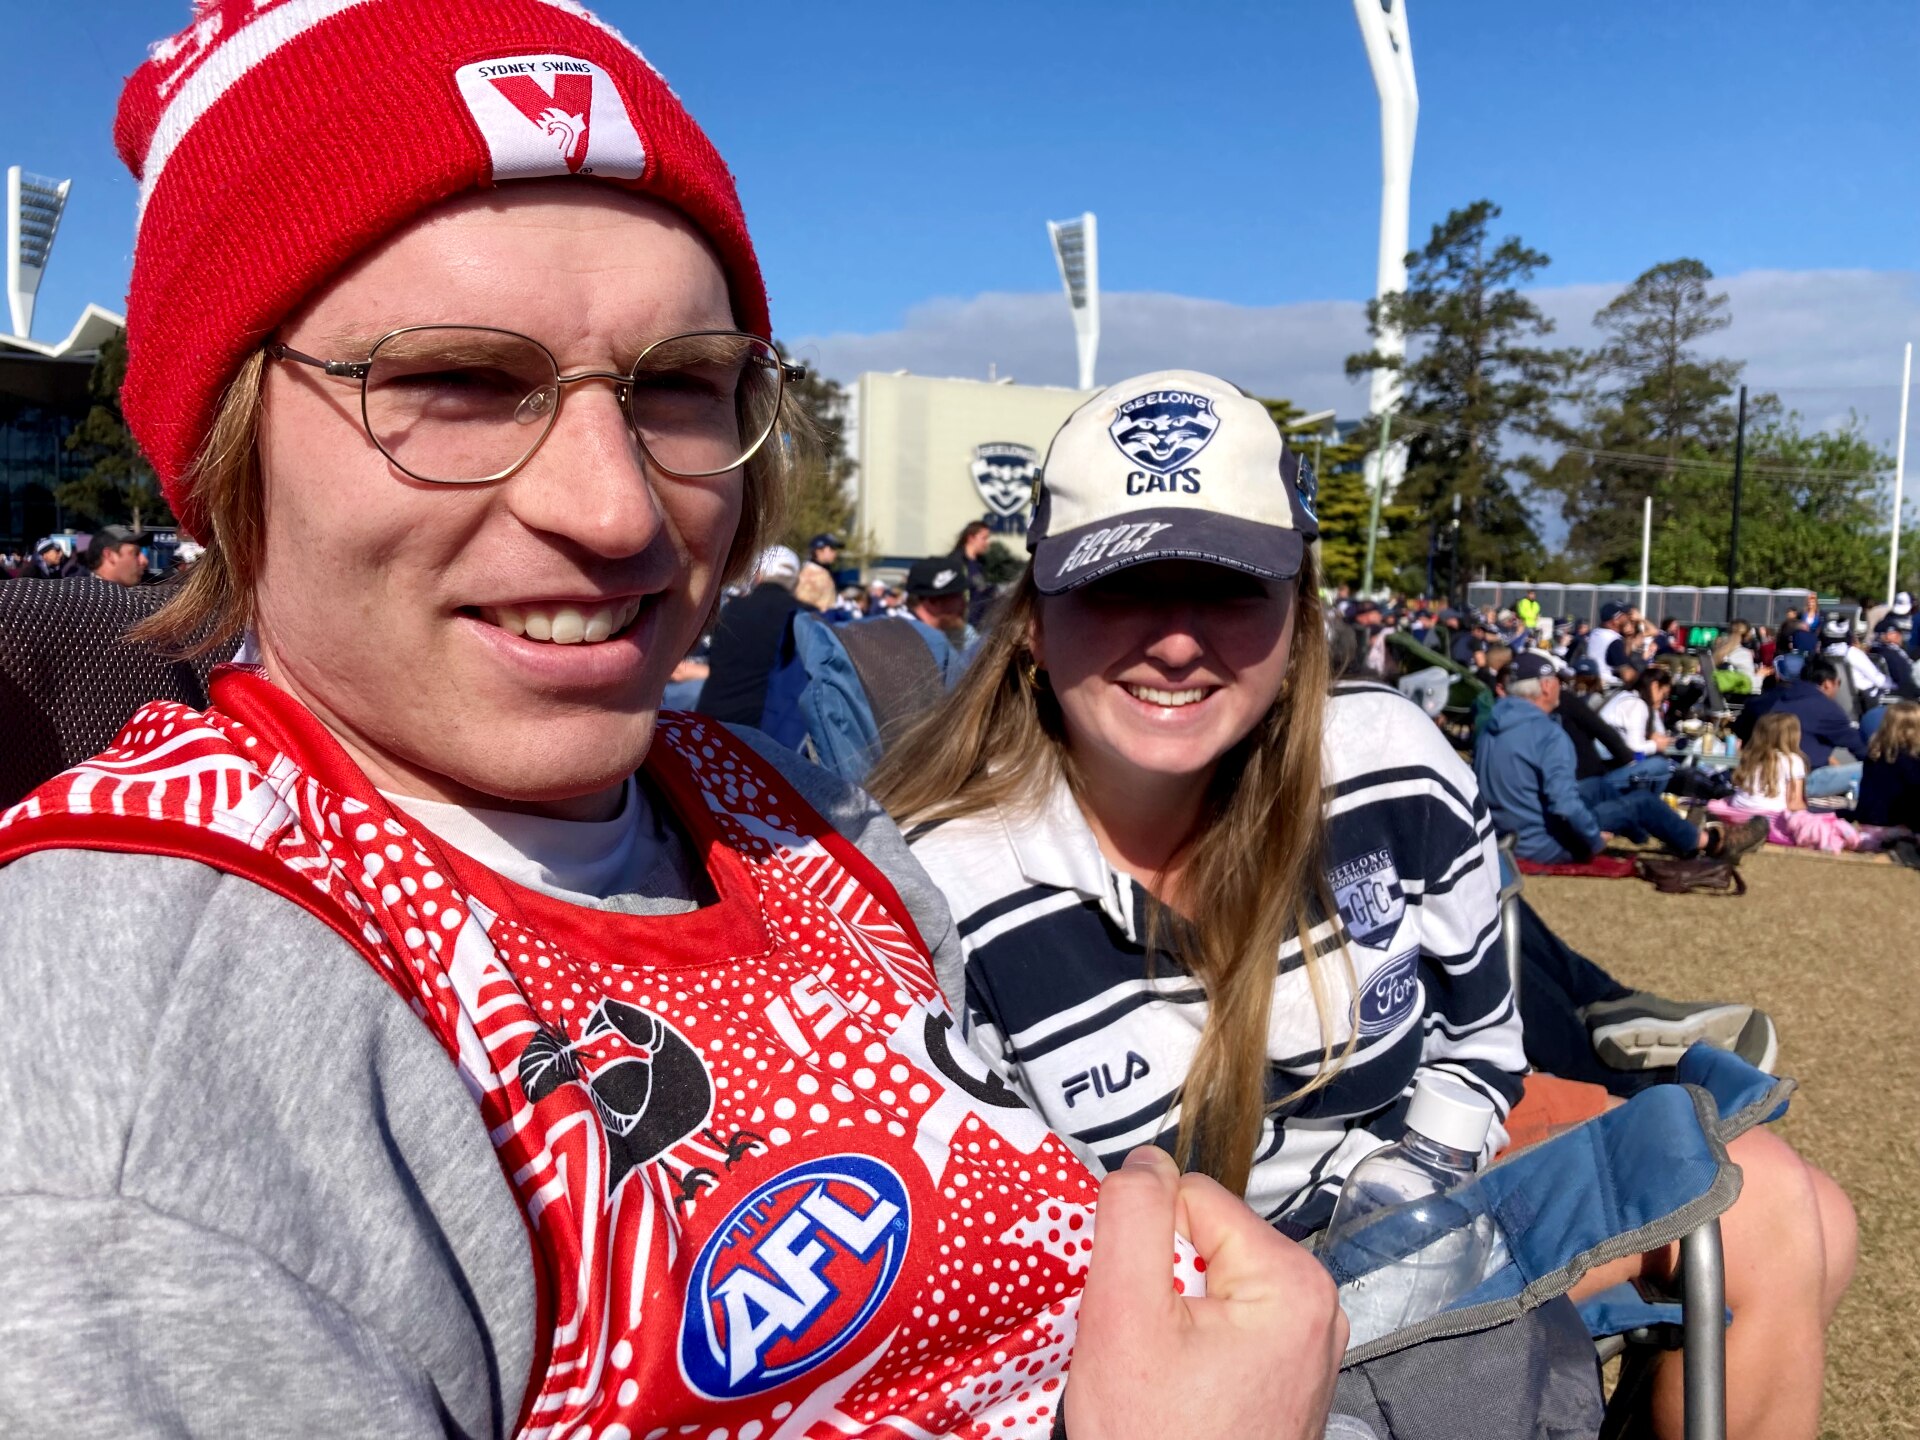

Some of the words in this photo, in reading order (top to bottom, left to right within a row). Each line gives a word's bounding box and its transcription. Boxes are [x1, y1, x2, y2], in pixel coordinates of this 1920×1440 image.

[478, 62, 536, 78] SYDNEY
[542, 61, 591, 73] SWANS
[1122, 392, 1207, 414] GEELONG
[1126, 467, 1201, 496] CATS
[1069, 522, 1173, 558] FOOTY
[1055, 544, 1108, 578] FULL
[1107, 537, 1152, 557] ON
[1327, 849, 1389, 882] GEELONG
[1331, 868, 1367, 893] FOOTBALL
[1349, 879, 1390, 929] GFC
[1061, 1050, 1150, 1108] FILA
[710, 1181, 901, 1388] AFL
